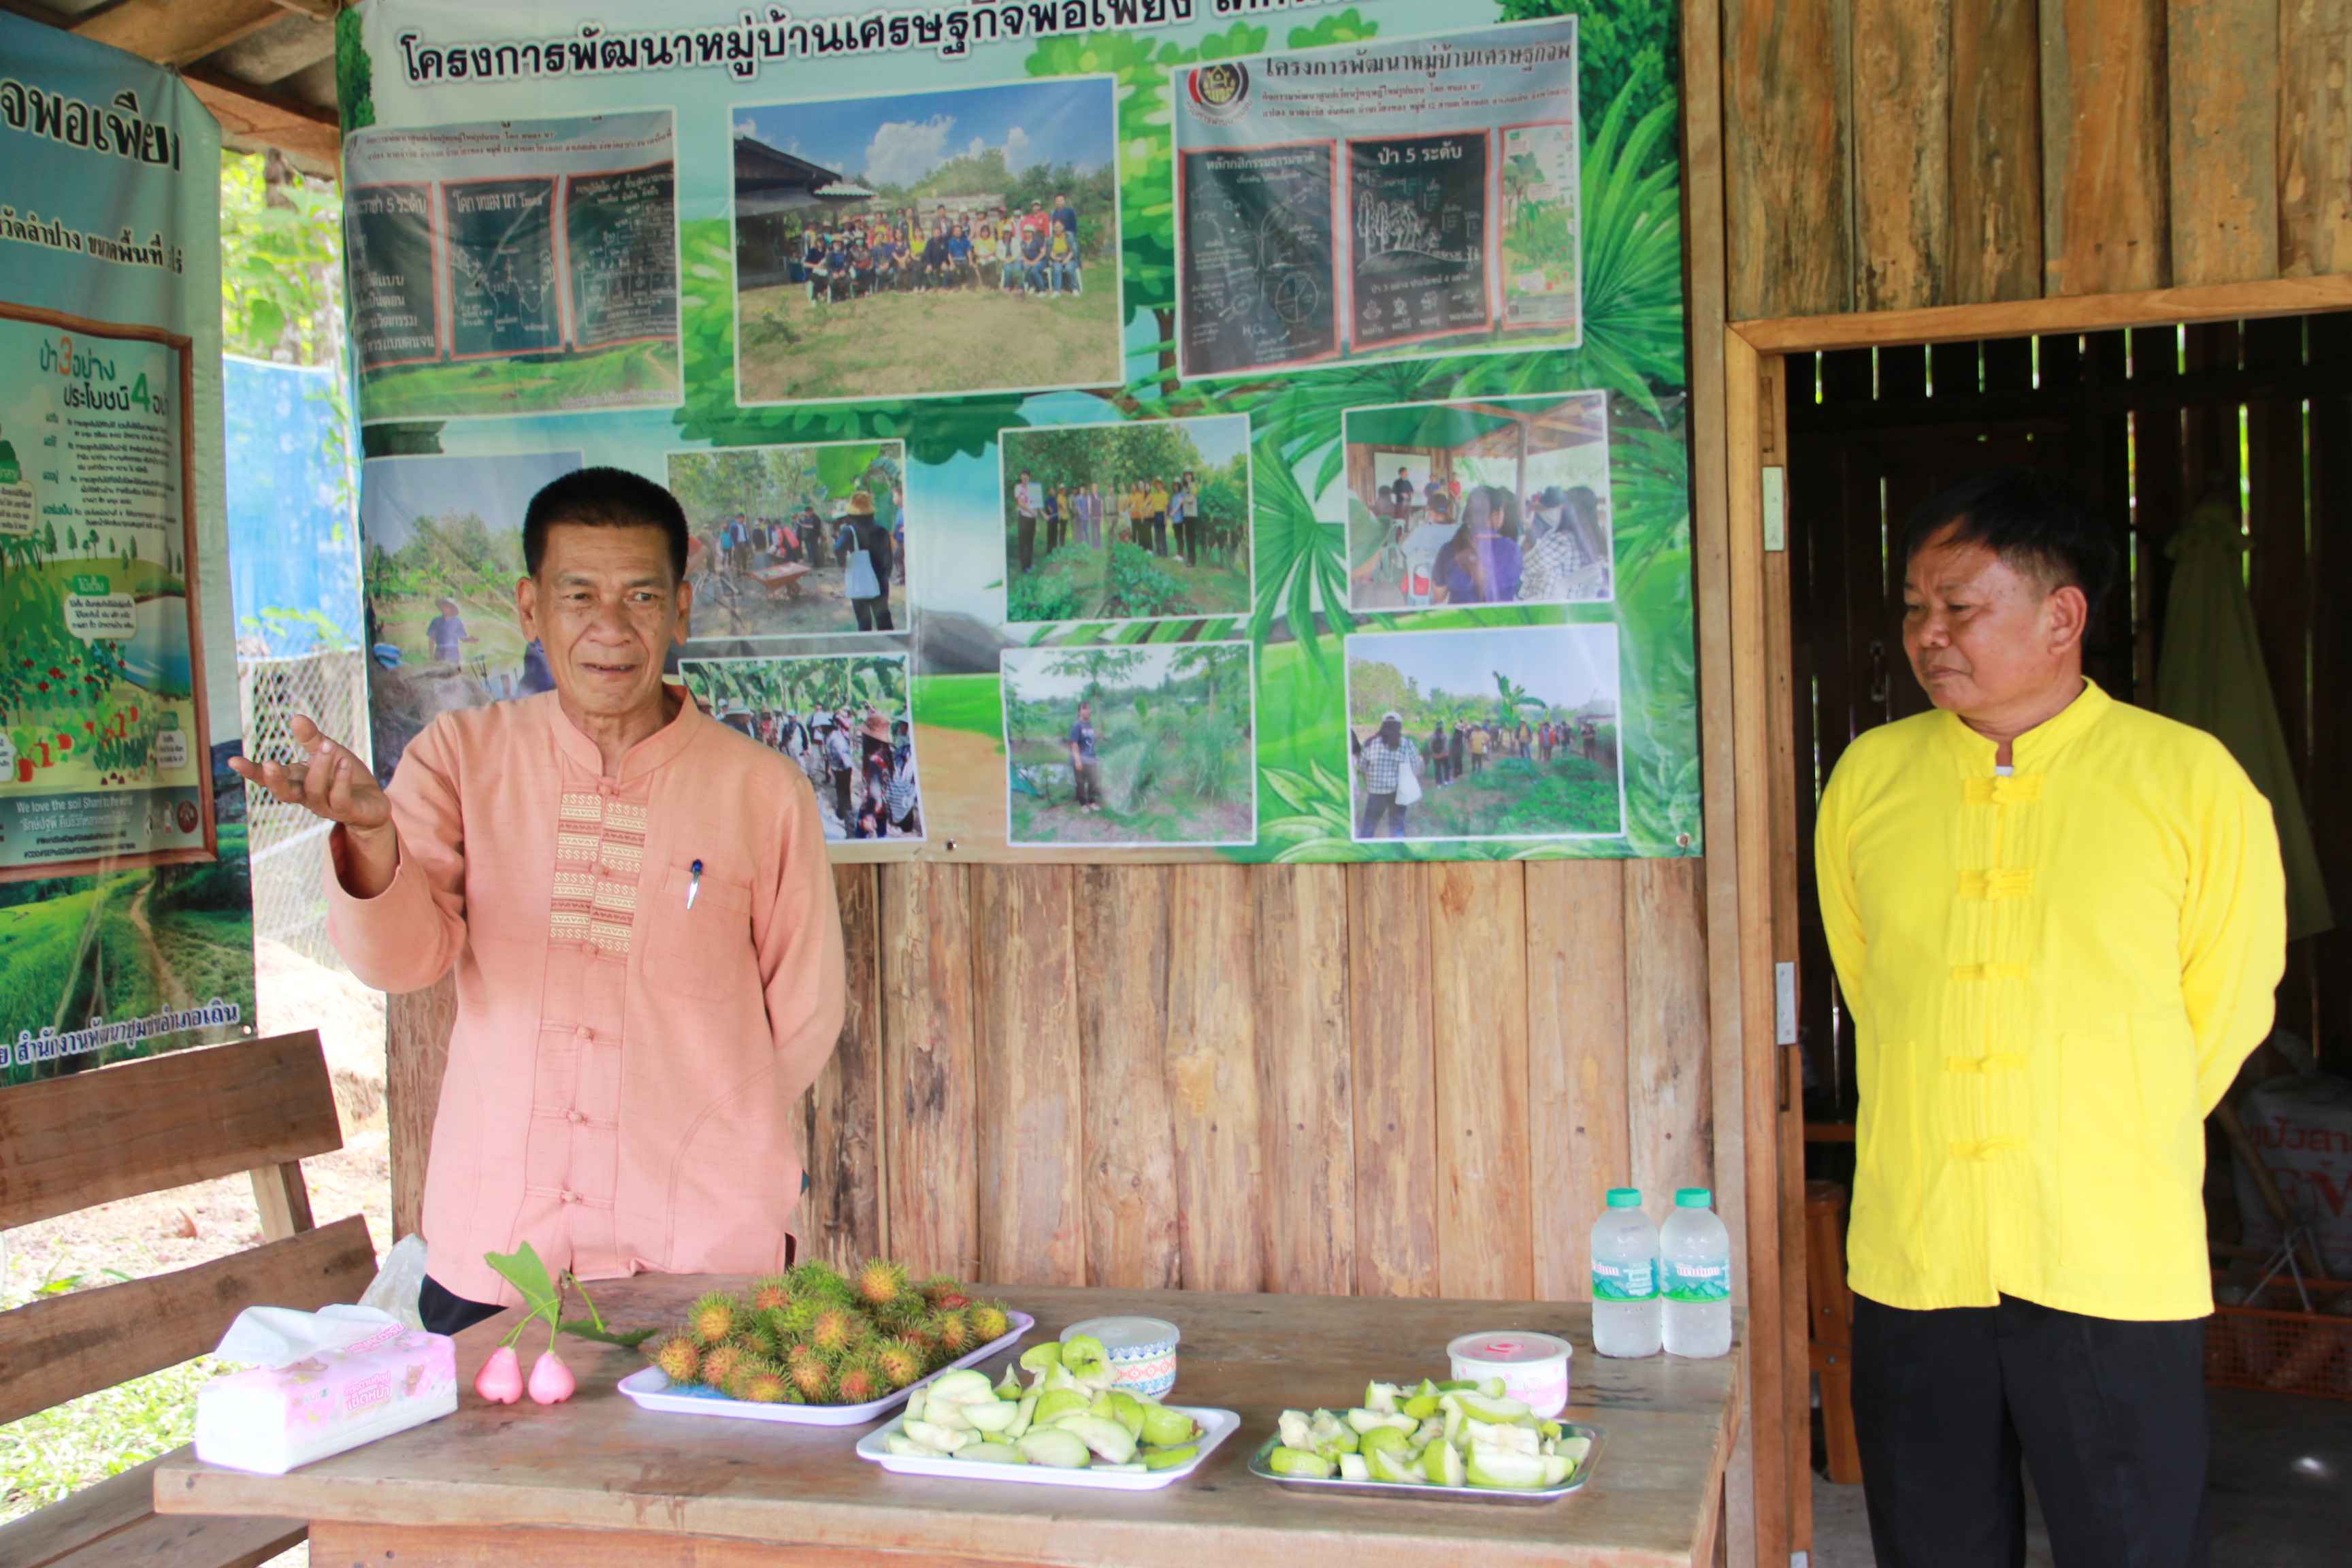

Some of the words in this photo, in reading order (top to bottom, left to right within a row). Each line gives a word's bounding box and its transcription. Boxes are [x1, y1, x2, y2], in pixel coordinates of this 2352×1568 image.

[1377, 146, 1399, 165] ป่า
[1405, 148, 1416, 164] 5
[1421, 140, 1463, 162] ระดับ
[386, 197, 395, 213] 5
[0, 208, 81, 250] วัดลำปาง
[16, 800, 30, 813] We
[31, 799, 50, 812] love
[52, 798, 66, 811] the
[67, 796, 82, 810] soil
[346, 1385, 392, 1411] เช็ดหน้า
